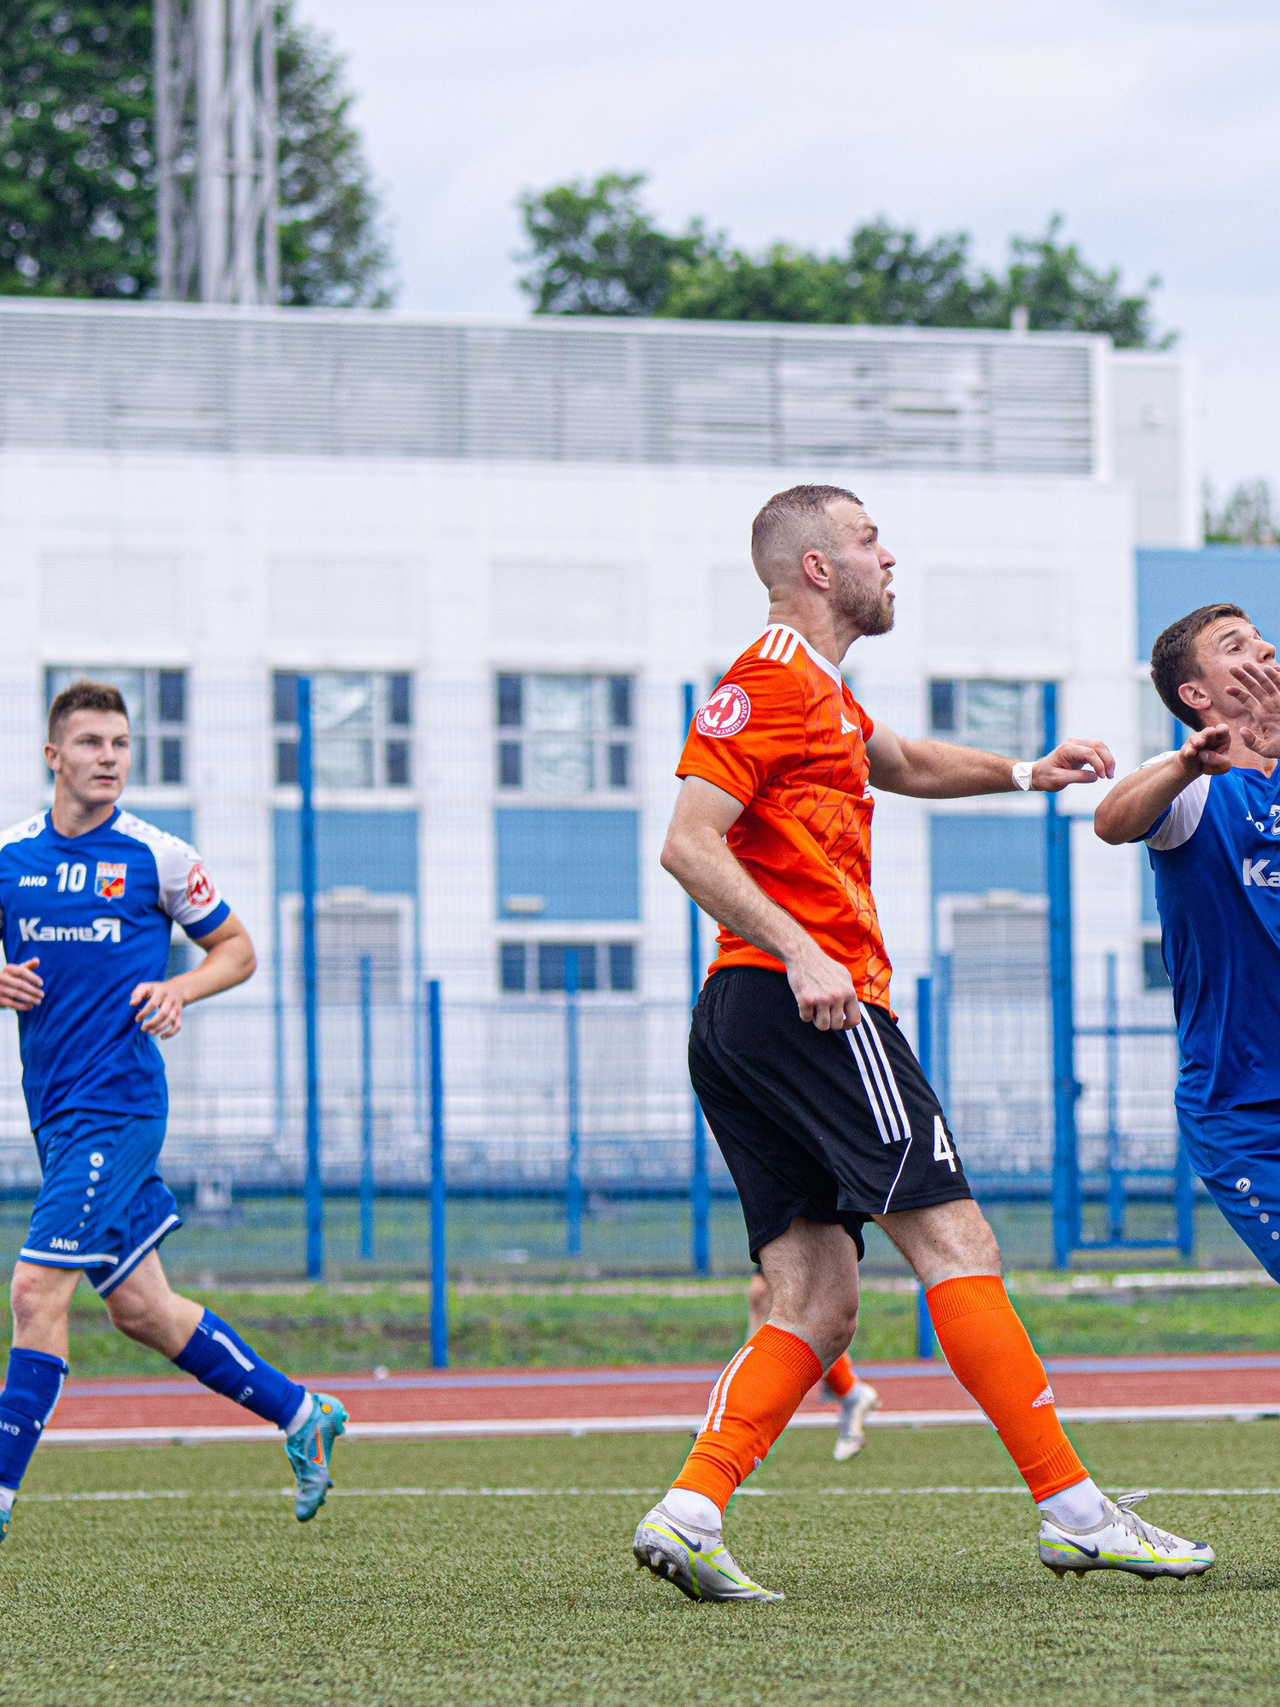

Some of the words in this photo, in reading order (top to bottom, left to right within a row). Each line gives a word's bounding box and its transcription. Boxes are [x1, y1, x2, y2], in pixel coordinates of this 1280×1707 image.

[19, 876, 48, 887] JAKO
[56, 862, 87, 893] 10
[933, 1115, 957, 1173] 4
[50, 1236, 79, 1251] JAKO
